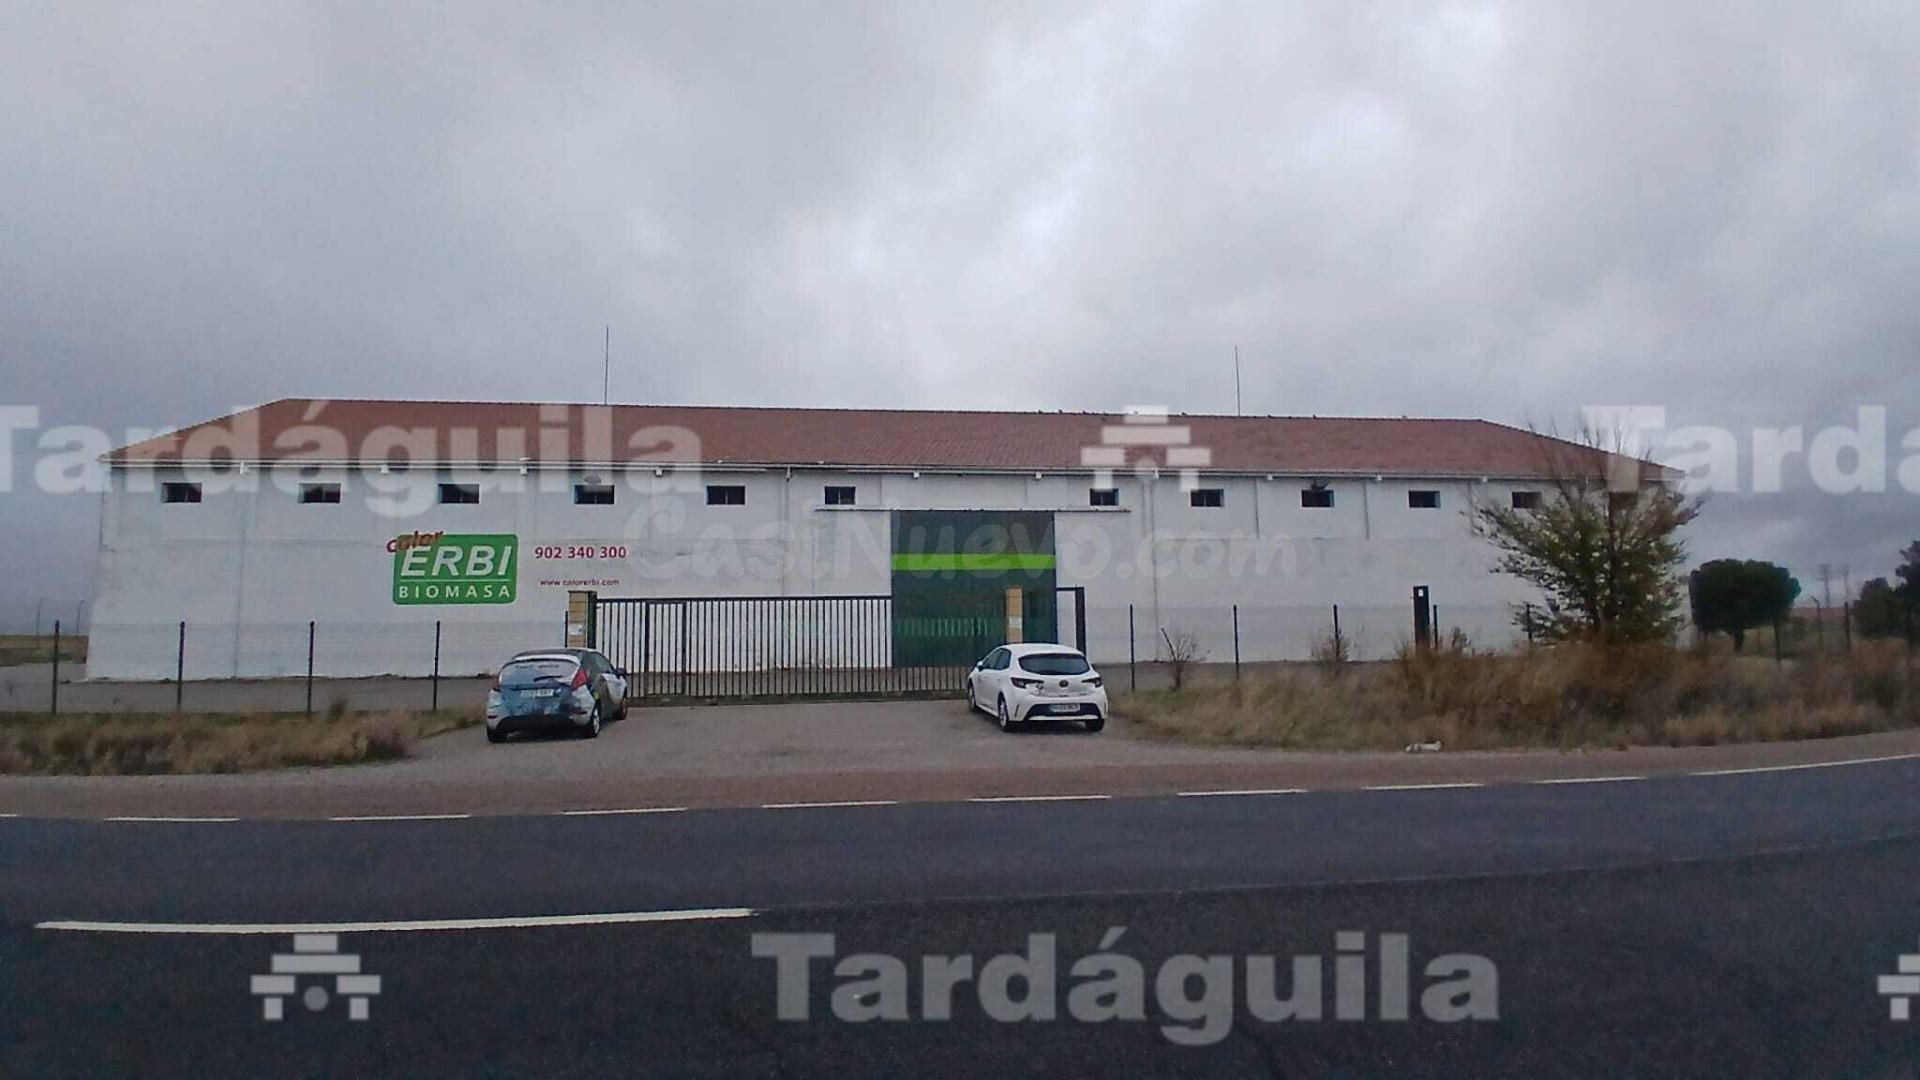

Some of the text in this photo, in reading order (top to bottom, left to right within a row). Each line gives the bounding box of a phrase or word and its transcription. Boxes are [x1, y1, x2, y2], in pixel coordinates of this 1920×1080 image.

[386, 530, 444, 553] calor
[400, 545, 512, 577] ERBI
[534, 546, 627, 560] 902 340 300
[399, 584, 511, 599] BIOMASA
